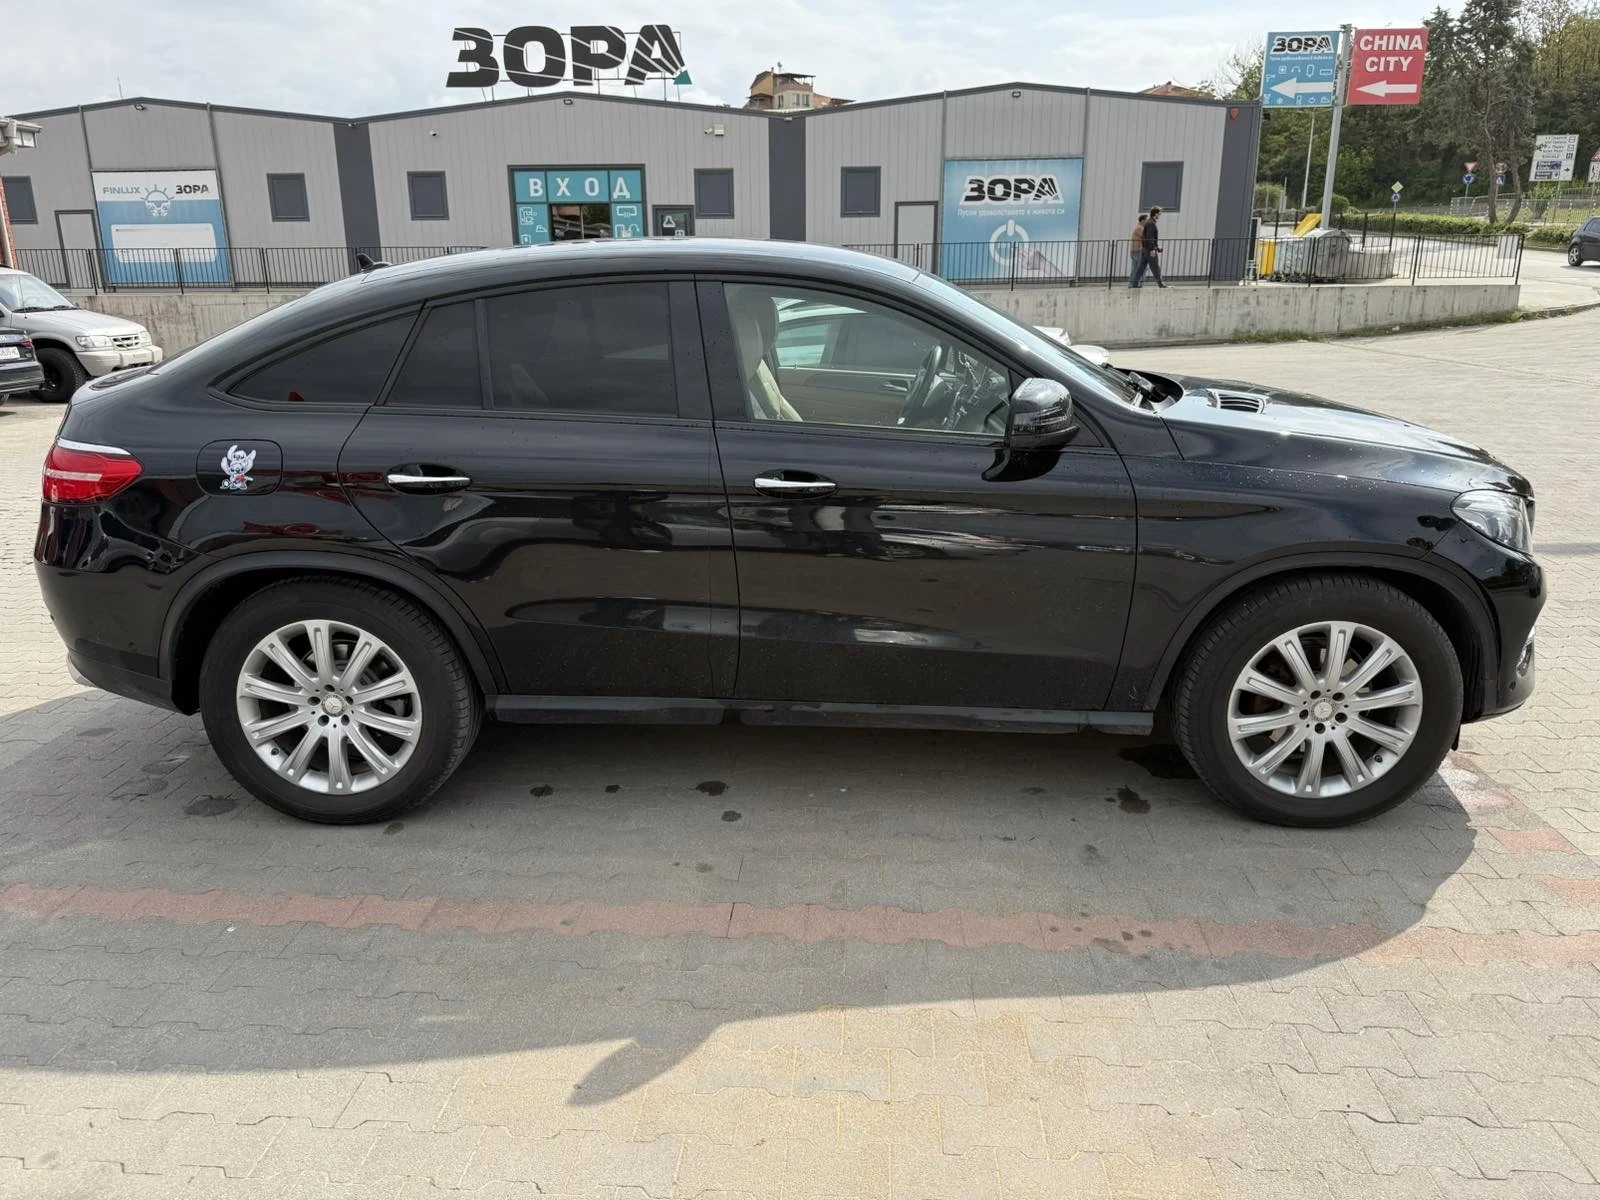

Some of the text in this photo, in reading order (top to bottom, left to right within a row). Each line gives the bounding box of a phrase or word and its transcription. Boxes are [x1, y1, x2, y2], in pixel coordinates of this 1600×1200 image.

[1271, 36, 1333, 53] ЗОРА
[1359, 35, 1423, 50] CHINA
[446, 24, 692, 87] ЗОРА
[1365, 56, 1413, 72] CITY
[102, 186, 141, 194] FINLUX
[176, 184, 209, 194] ЗОРА
[528, 176, 631, 199] ВХОД
[961, 176, 1063, 204] ЗОРА
